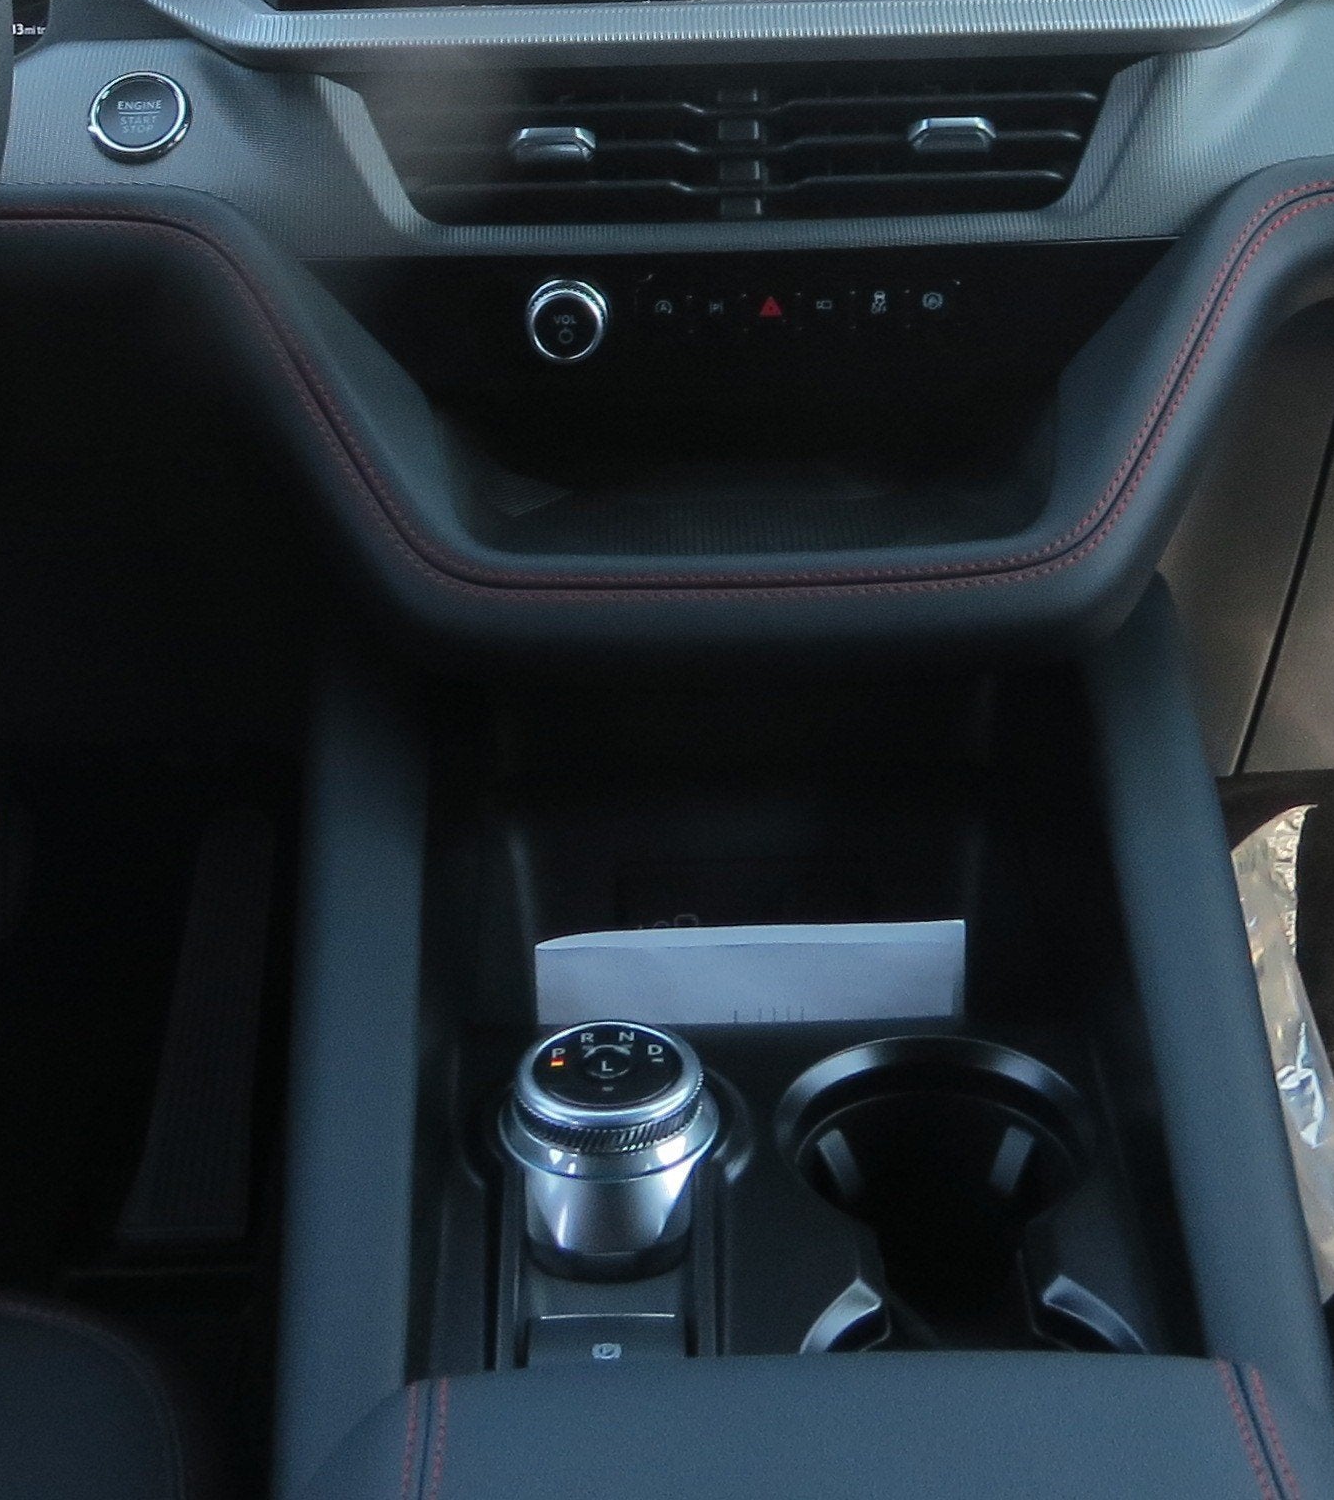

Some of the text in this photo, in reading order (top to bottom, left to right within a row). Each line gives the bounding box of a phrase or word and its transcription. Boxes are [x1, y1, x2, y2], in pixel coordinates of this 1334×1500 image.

[117, 100, 162, 110] ENGINE
[120, 115, 157, 125] START
[122, 124, 154, 134] STOP
[553, 314, 578, 326] VOL
[580, 1032, 594, 1044] R
[618, 1031, 636, 1043] N
[551, 1048, 566, 1060] P
[647, 1044, 664, 1056] D
[601, 1060, 613, 1072] L
